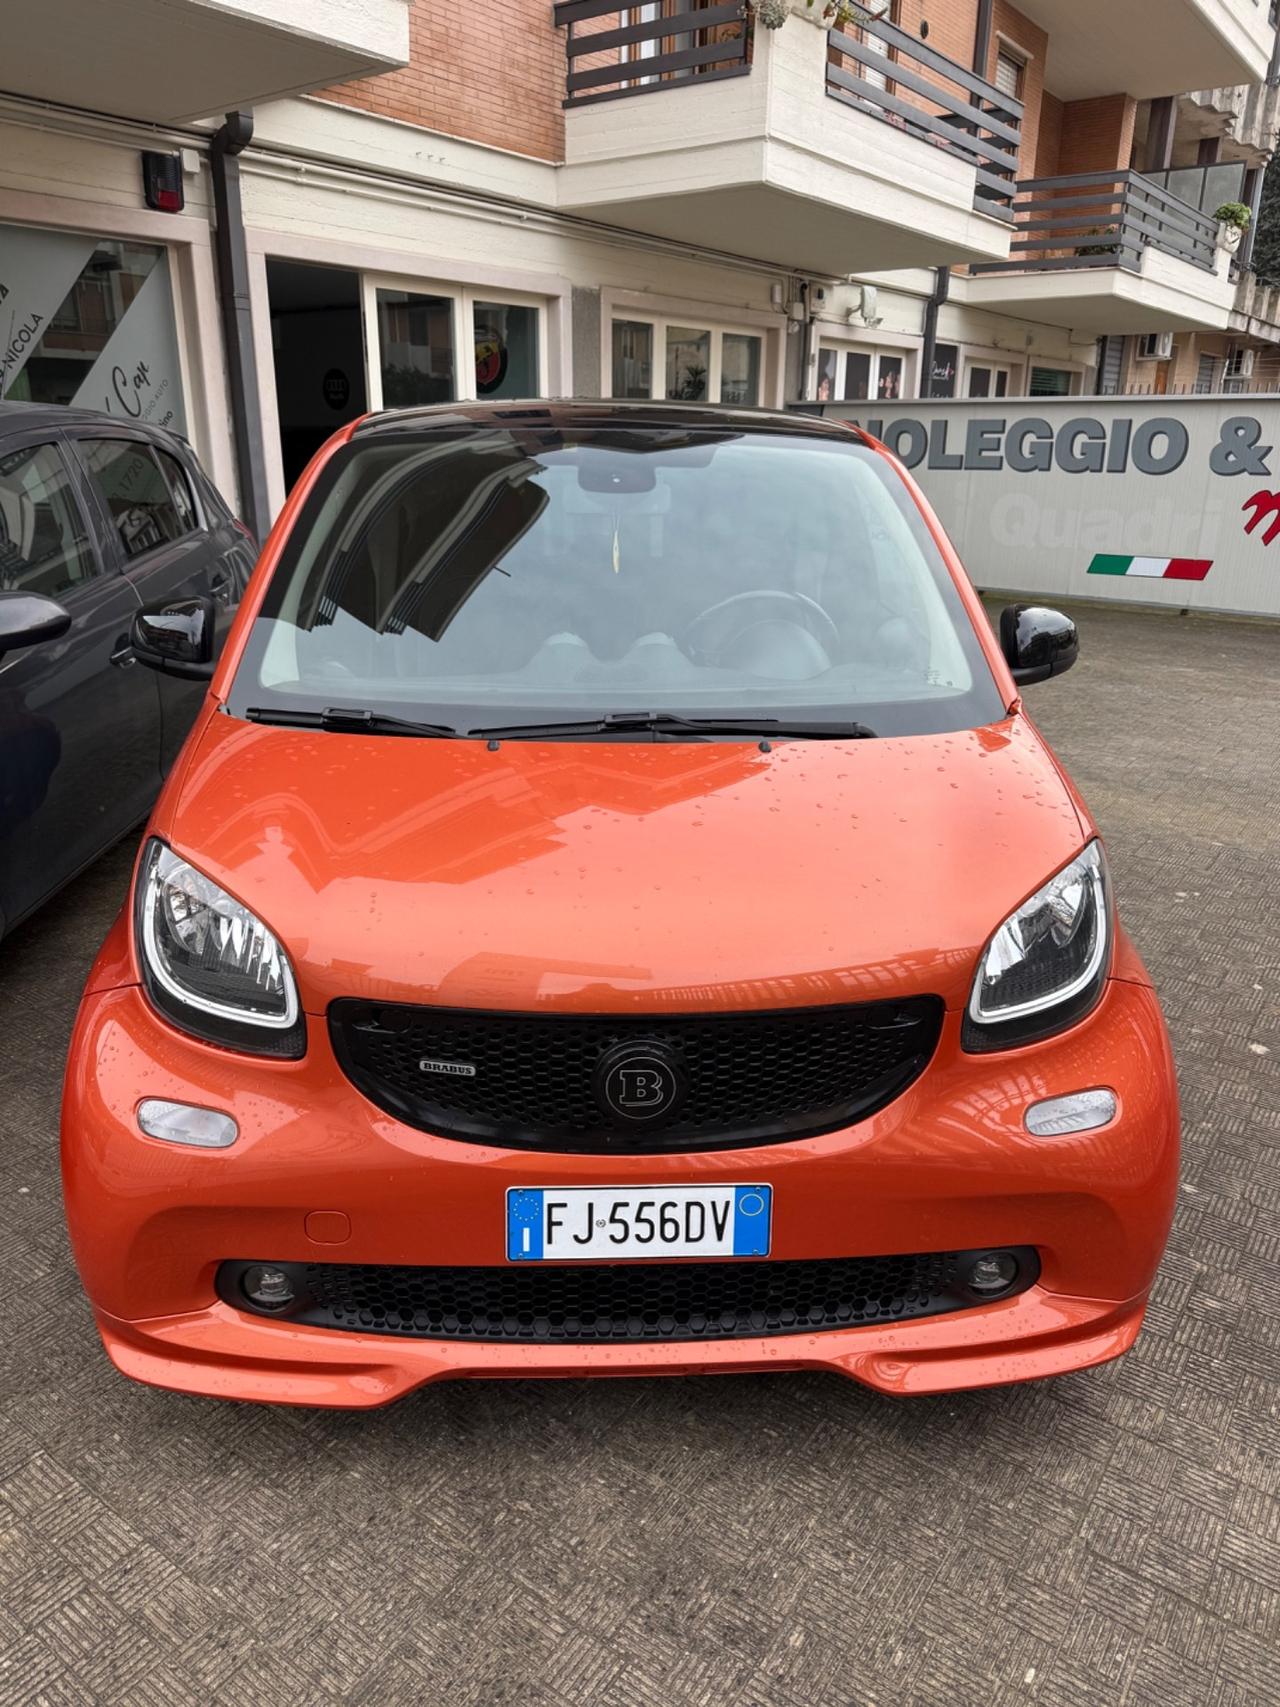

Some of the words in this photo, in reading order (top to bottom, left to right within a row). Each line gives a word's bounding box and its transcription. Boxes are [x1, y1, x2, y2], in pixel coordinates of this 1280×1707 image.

[2, 313, 44, 369] NICOLA
[1209, 416, 1273, 476] &
[423, 1061, 473, 1076] BRABUS
[619, 1070, 664, 1107] B
